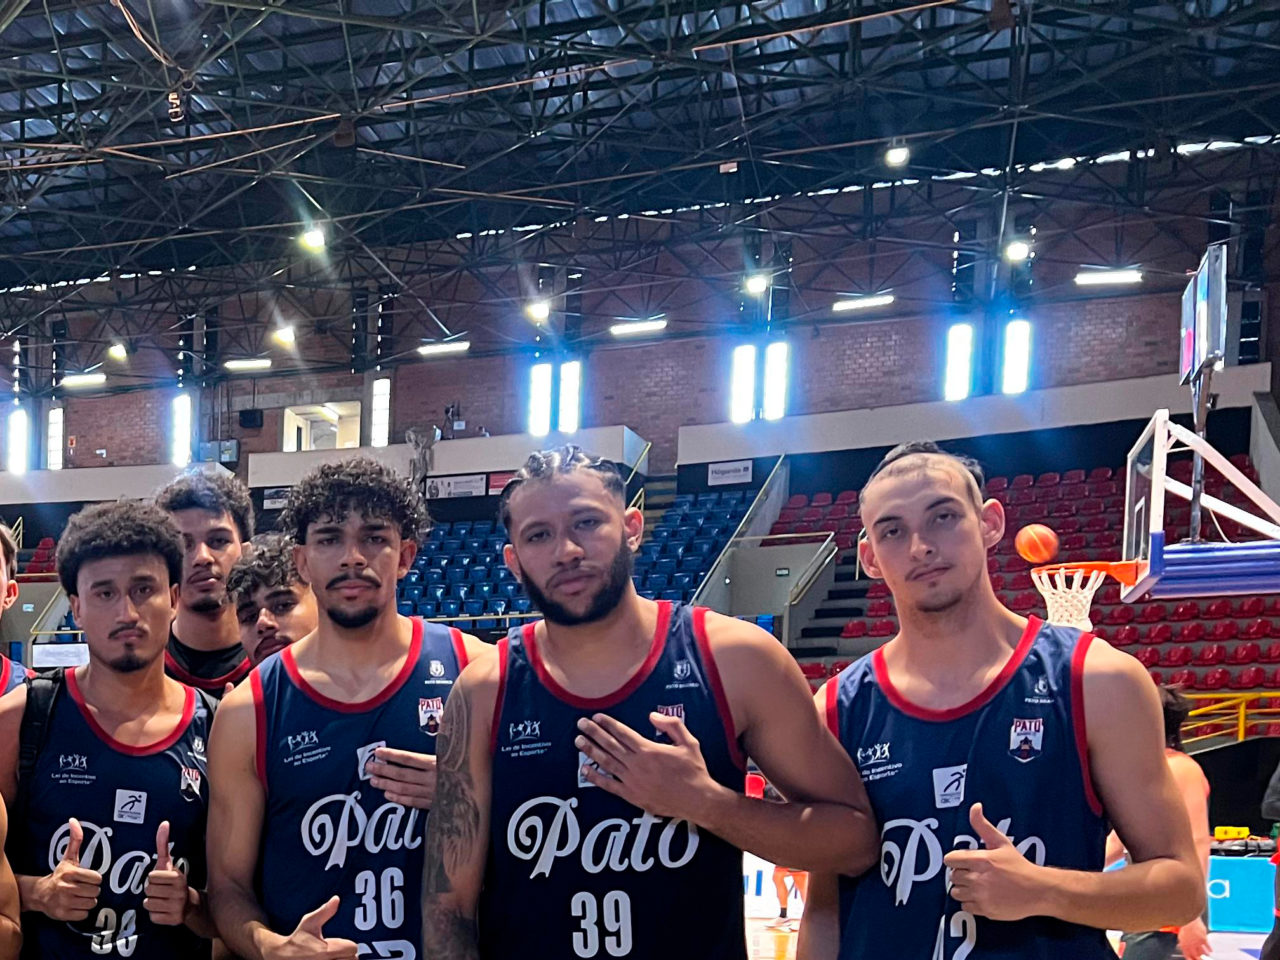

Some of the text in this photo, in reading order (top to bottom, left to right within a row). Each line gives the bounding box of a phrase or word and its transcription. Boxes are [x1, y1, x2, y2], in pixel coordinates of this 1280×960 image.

[420, 699, 442, 711] PATO
[1013, 718, 1042, 733] PATO
[301, 790, 422, 871] Pat
[506, 796, 700, 879] Pato
[354, 866, 405, 931] 36
[571, 890, 633, 959] 39
